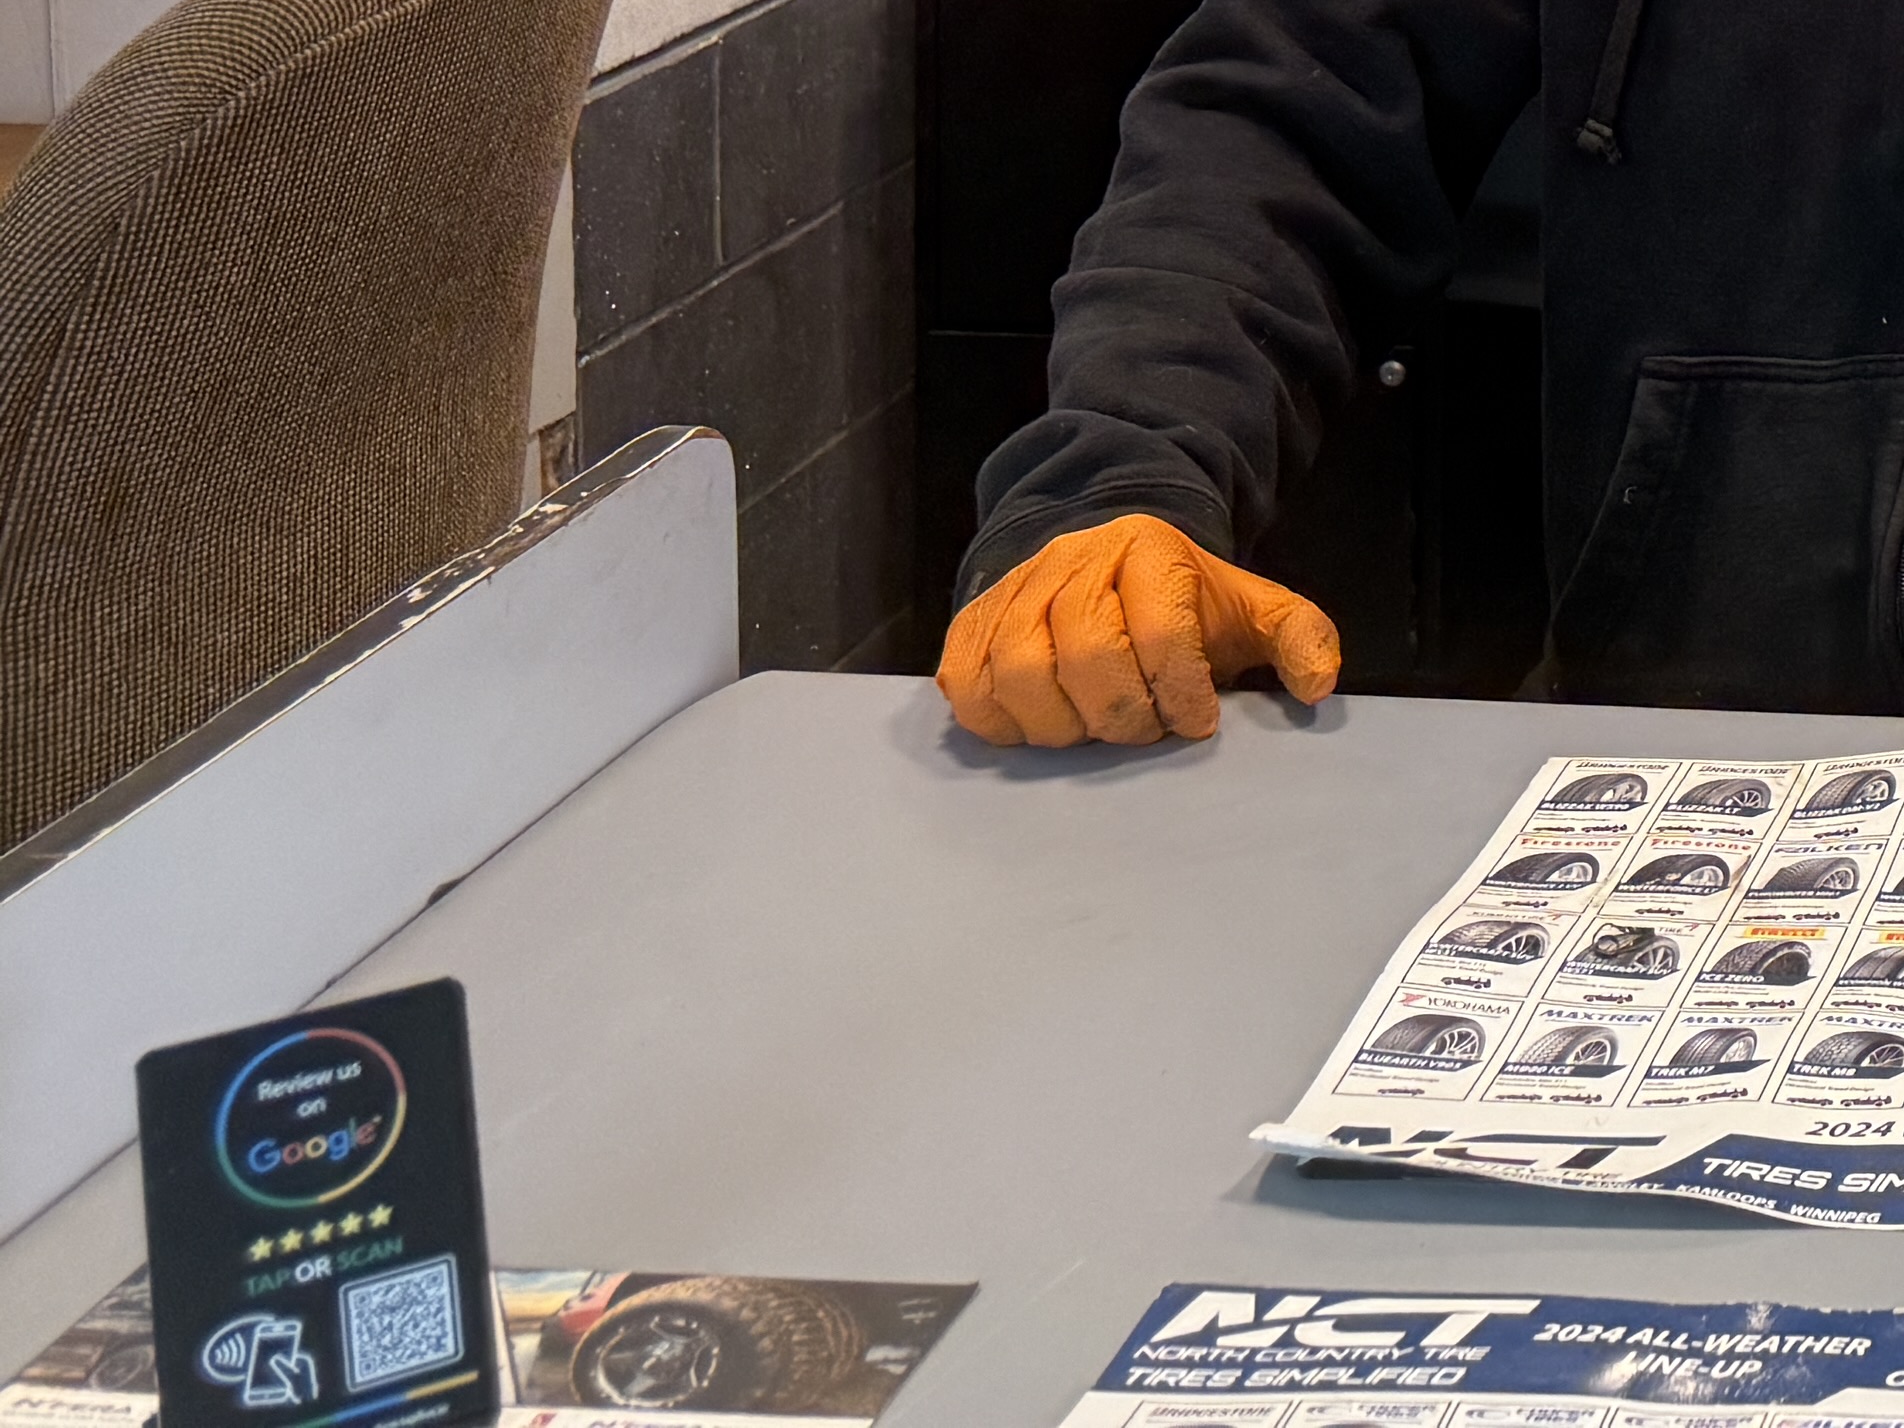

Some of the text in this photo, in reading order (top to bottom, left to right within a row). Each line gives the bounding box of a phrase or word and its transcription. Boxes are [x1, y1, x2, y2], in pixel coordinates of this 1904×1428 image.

[1520, 837, 1622, 848] Firestone
[1651, 838, 1751, 850] Firestone
[1700, 973, 1765, 983] ICE ZERO
[1428, 997, 1510, 1015] YOKOHAMA
[1539, 1009, 1656, 1023] MAXTREK
[1681, 1014, 1795, 1024] MAXTREK
[1550, 1066, 1574, 1075] ICE
[1651, 1066, 1715, 1077] TREK M7
[1793, 1064, 1829, 1074] TREK
[257, 1060, 362, 1101] Review us
[297, 1097, 327, 1117] on
[1805, 1120, 1894, 1139] 2024
[247, 1115, 377, 1173] Google
[1702, 1157, 1832, 1190] TIRES
[1675, 1183, 1882, 1224] KAMLOOPS WINNIPEG
[246, 1237, 403, 1297] TAP OR SCAN
[1150, 1290, 1541, 1348] NCT
[1533, 1324, 1872, 1357] 2024 ALL-WEATHER
[1133, 1344, 1491, 1363] NORTH COUNTRY TIRE
[1622, 1351, 1763, 1379] LINE-UP
[1124, 1366, 1467, 1388] TIRES SIMPLIFIED
